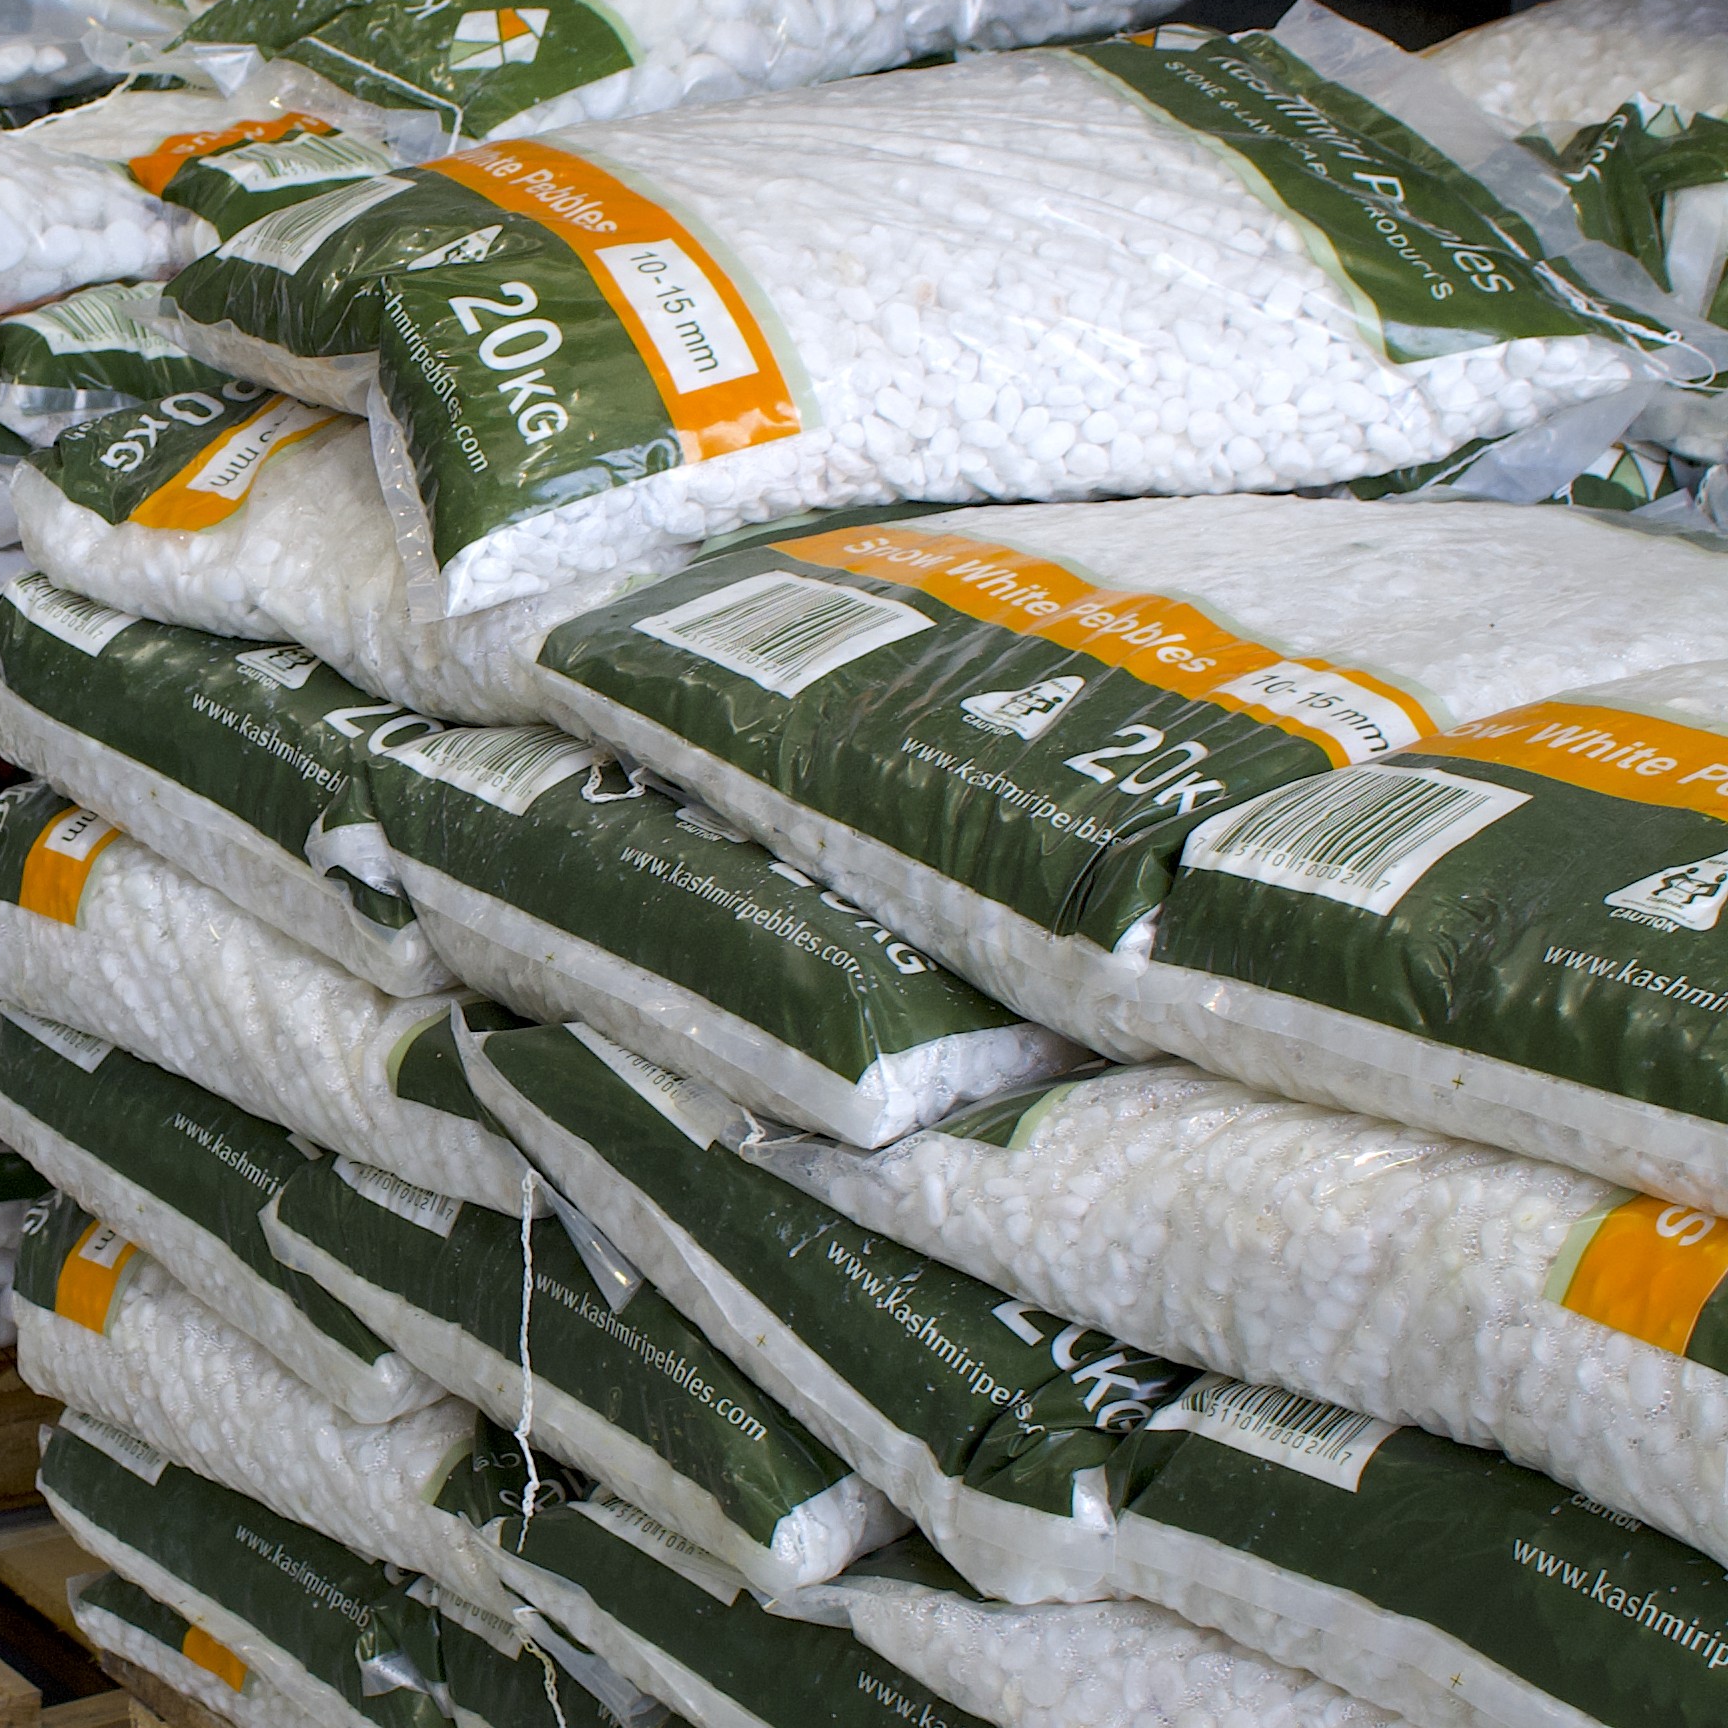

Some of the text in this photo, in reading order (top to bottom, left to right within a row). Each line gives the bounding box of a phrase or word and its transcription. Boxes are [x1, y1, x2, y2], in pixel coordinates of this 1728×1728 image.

[523, 166, 619, 236] Pebbles
[629, 250, 721, 374] 10-15 mm
[447, 278, 569, 447] 20KG
[843, 535, 1218, 675] Snow White Pebbles
[235, 663, 282, 692] CAUTION
[961, 713, 1017, 738] CAUTION
[1524, 721, 1683, 778] White
[1062, 723, 1227, 817] 20K
[676, 820, 724, 842] CAUTION
[1609, 907, 1681, 934] CAUTION
[1542, 942, 1728, 1014] www.kashmi
[533, 1270, 769, 1444] www.kashmiripebbles.com
[1570, 1493, 1644, 1532] CAUTION
